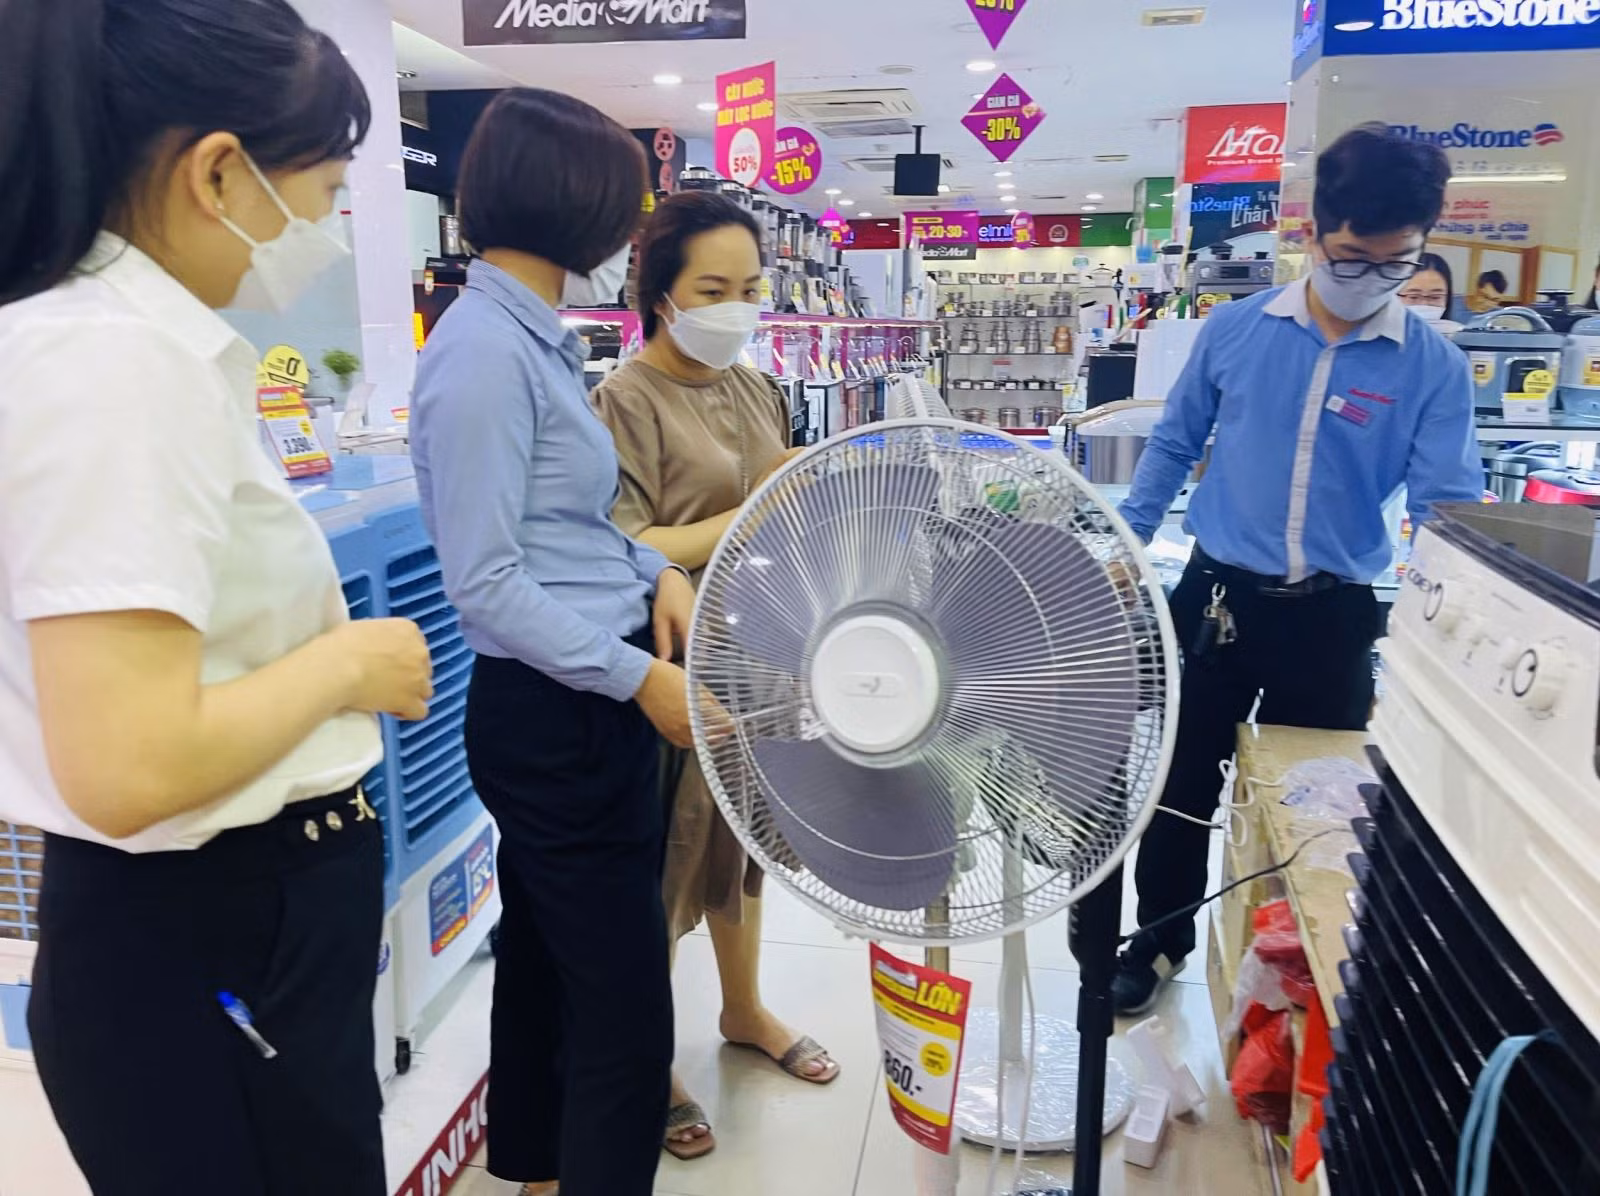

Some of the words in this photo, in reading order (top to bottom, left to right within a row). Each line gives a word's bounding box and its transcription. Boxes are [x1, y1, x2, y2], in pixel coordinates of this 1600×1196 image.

[494, 0, 597, 28] Media
[1380, 0, 1600, 30] BlueStone
[980, 117, 1021, 142] -30%
[733, 156, 757, 172] 50%
[770, 156, 812, 186] -15%
